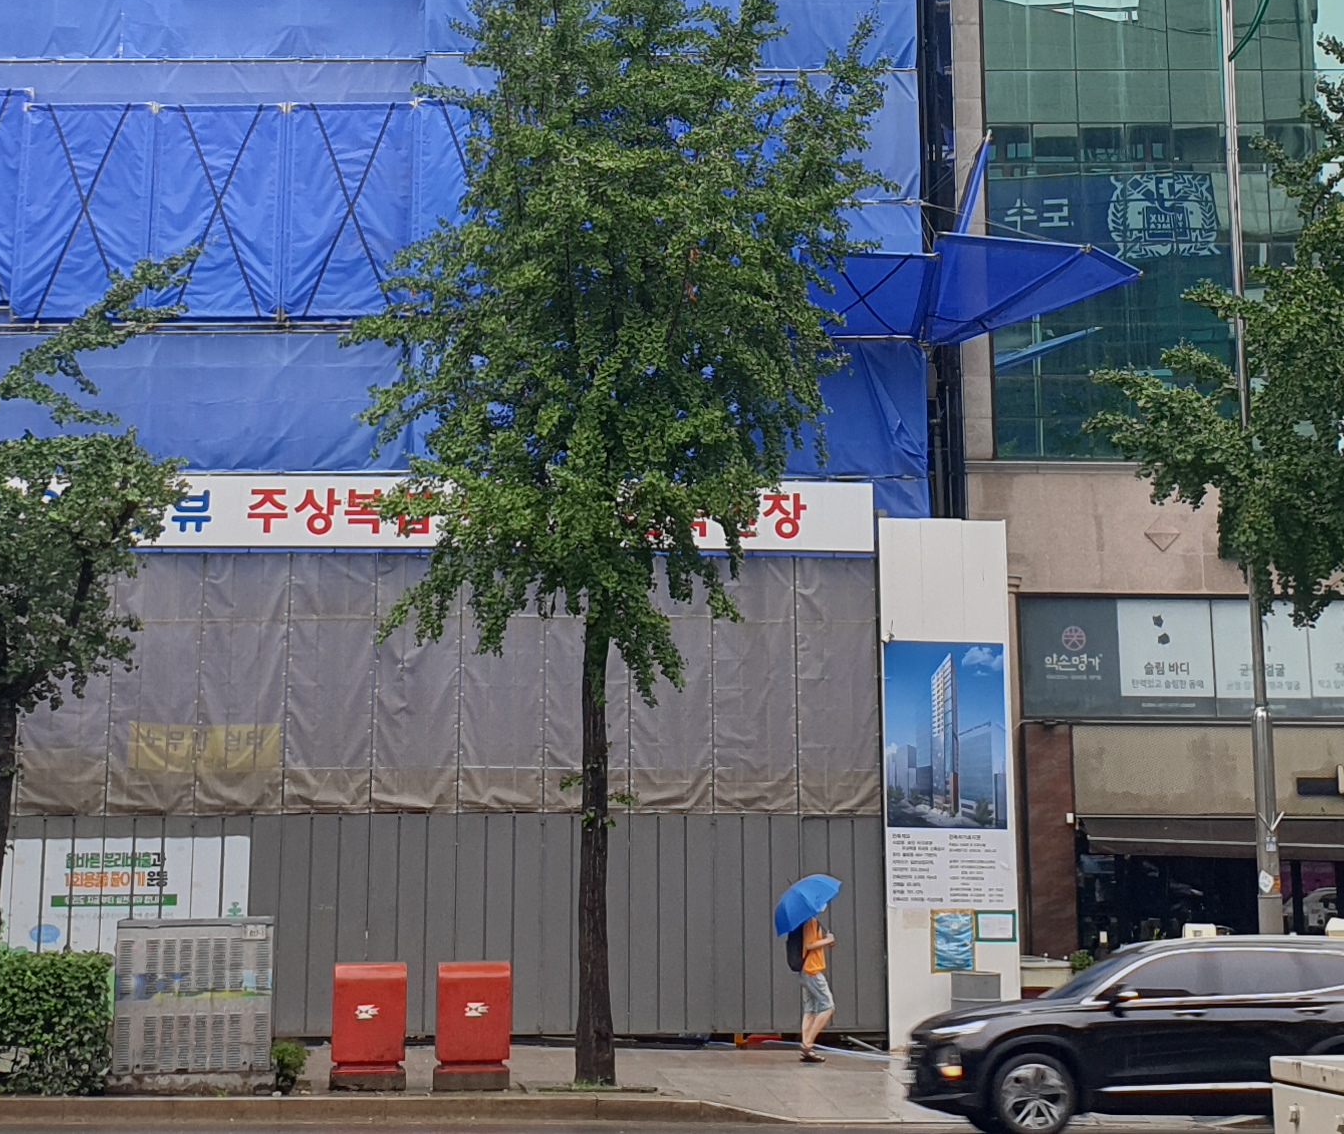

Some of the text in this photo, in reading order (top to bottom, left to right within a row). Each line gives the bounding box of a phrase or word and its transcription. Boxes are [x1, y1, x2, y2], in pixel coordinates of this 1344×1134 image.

[1044, 654, 1101, 671] 약손명가
[1144, 661, 1190, 676] 슬림 바디
